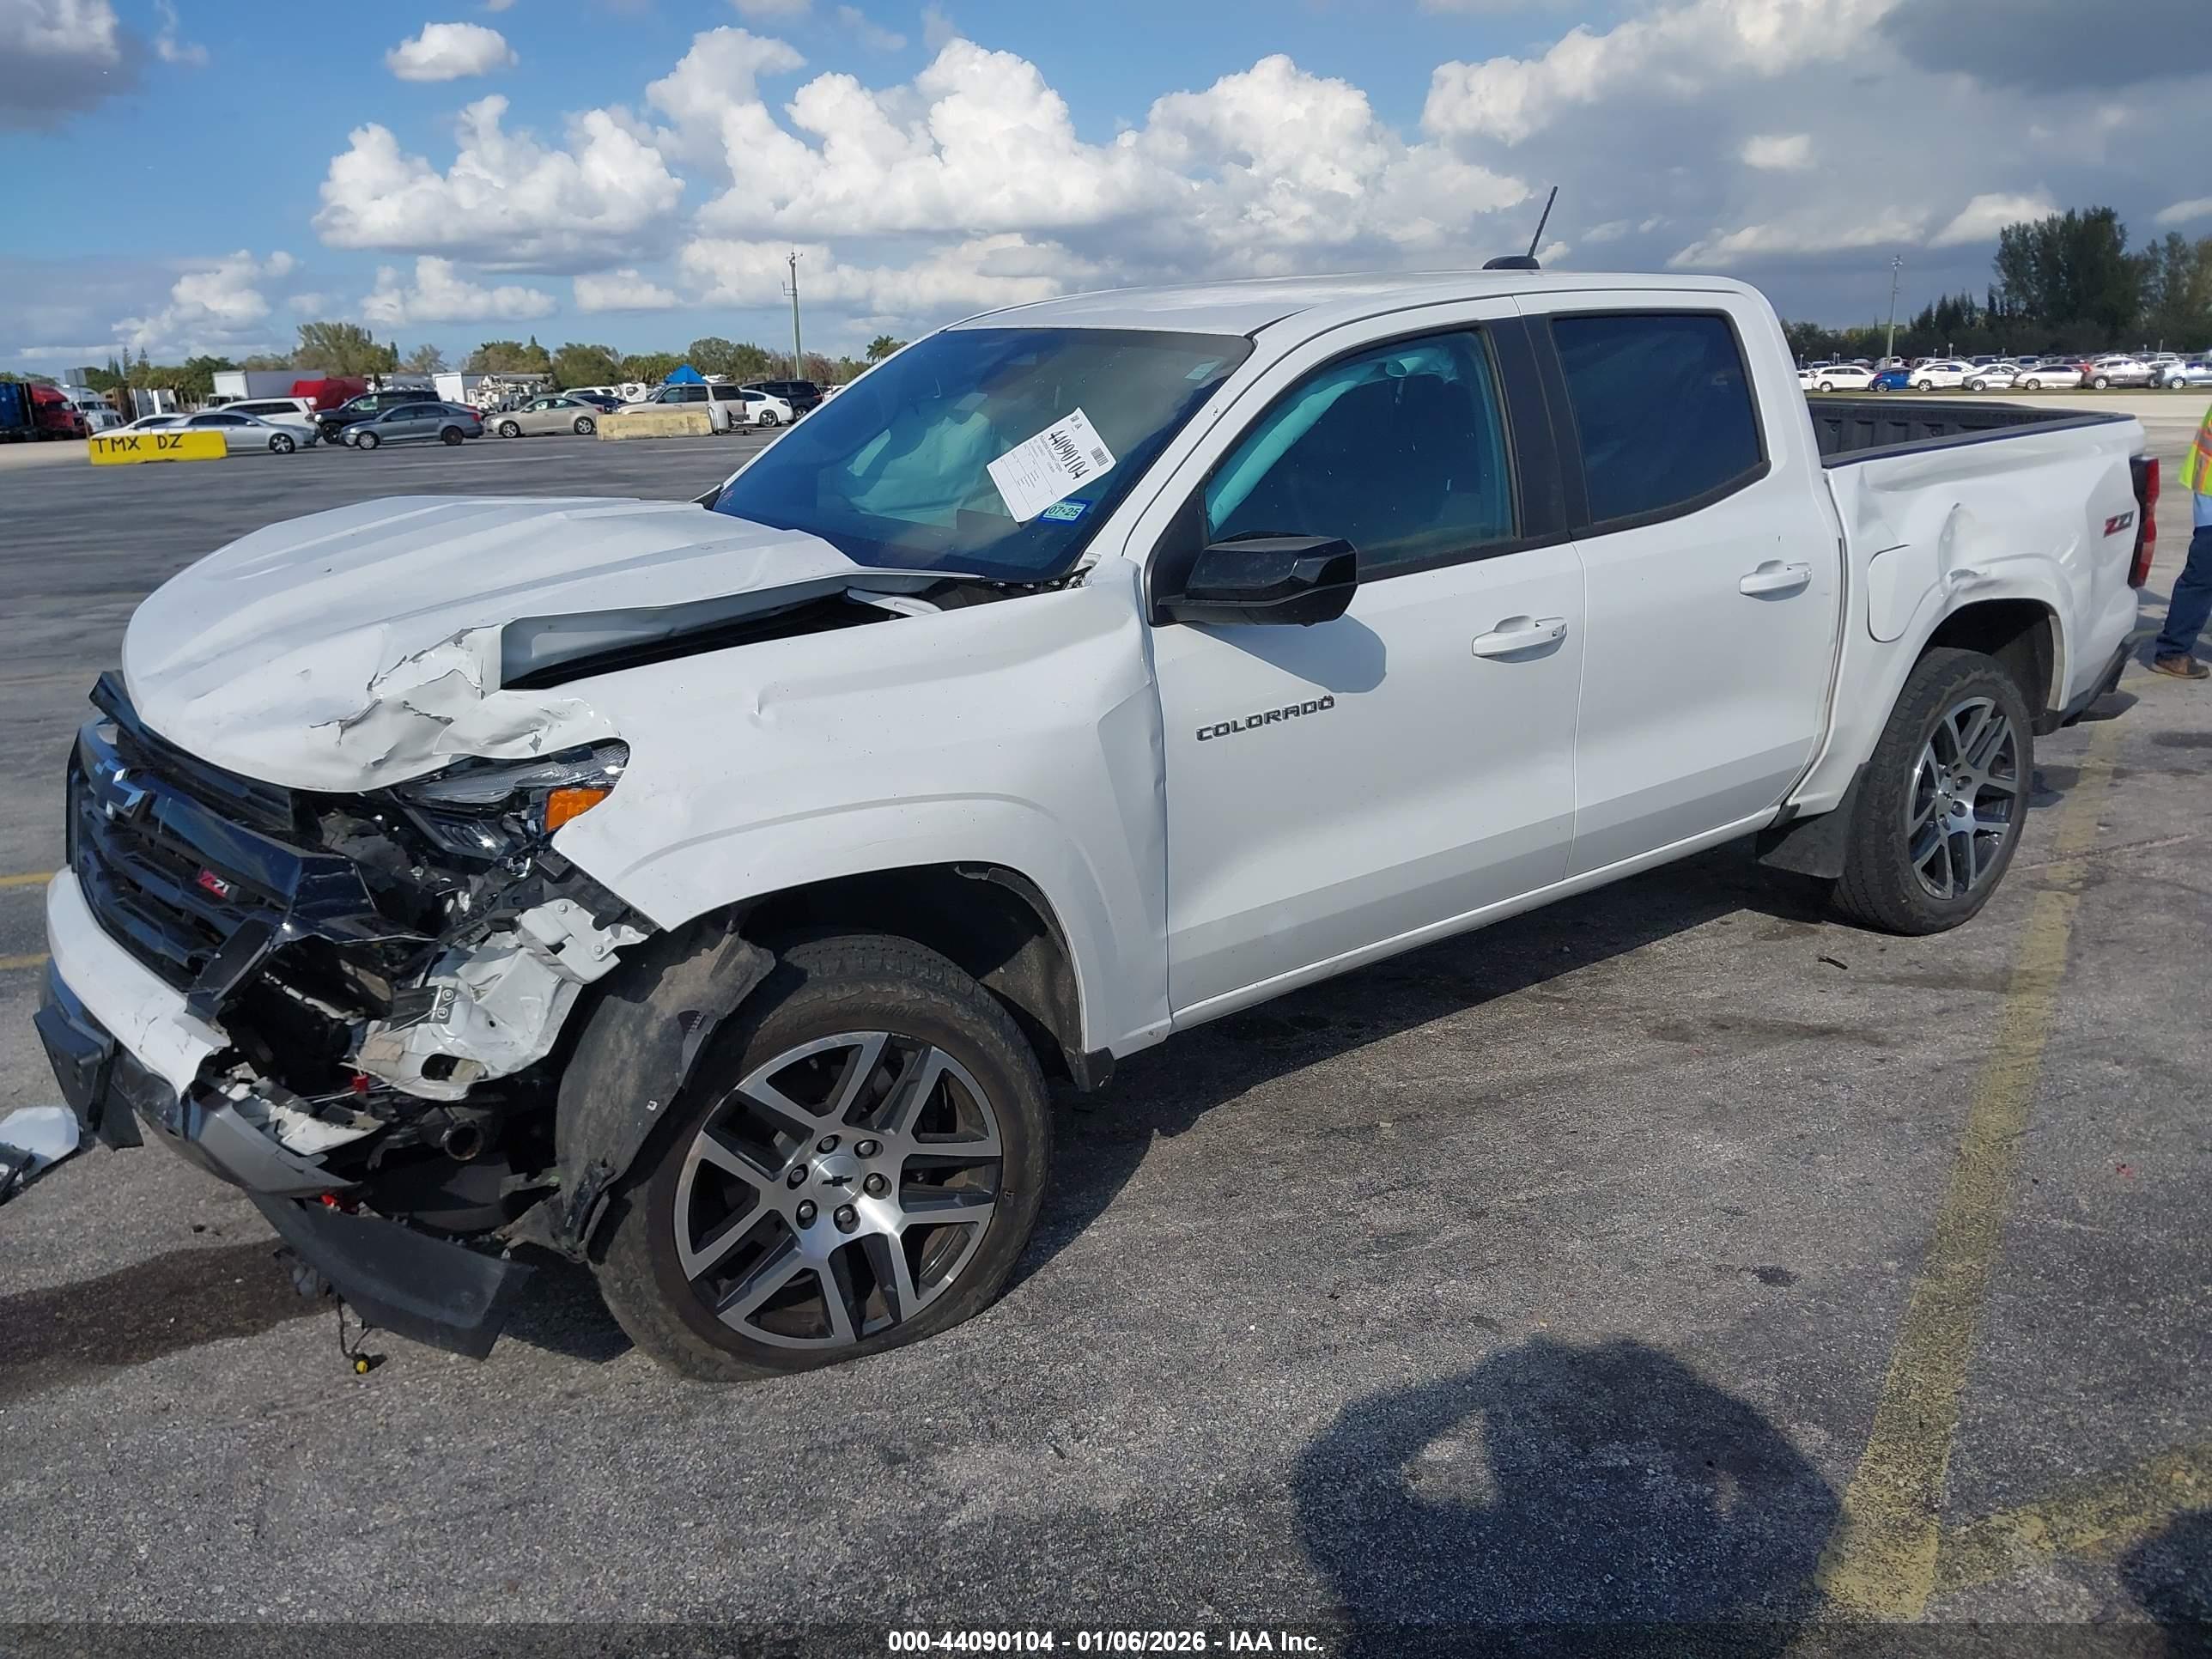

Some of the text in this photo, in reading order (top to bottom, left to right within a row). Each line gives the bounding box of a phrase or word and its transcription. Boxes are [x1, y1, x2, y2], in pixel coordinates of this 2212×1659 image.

[92, 433, 185, 453] TMX DZ
[1048, 430, 1091, 480] 44090104
[1196, 695, 1335, 742] COLORADO
